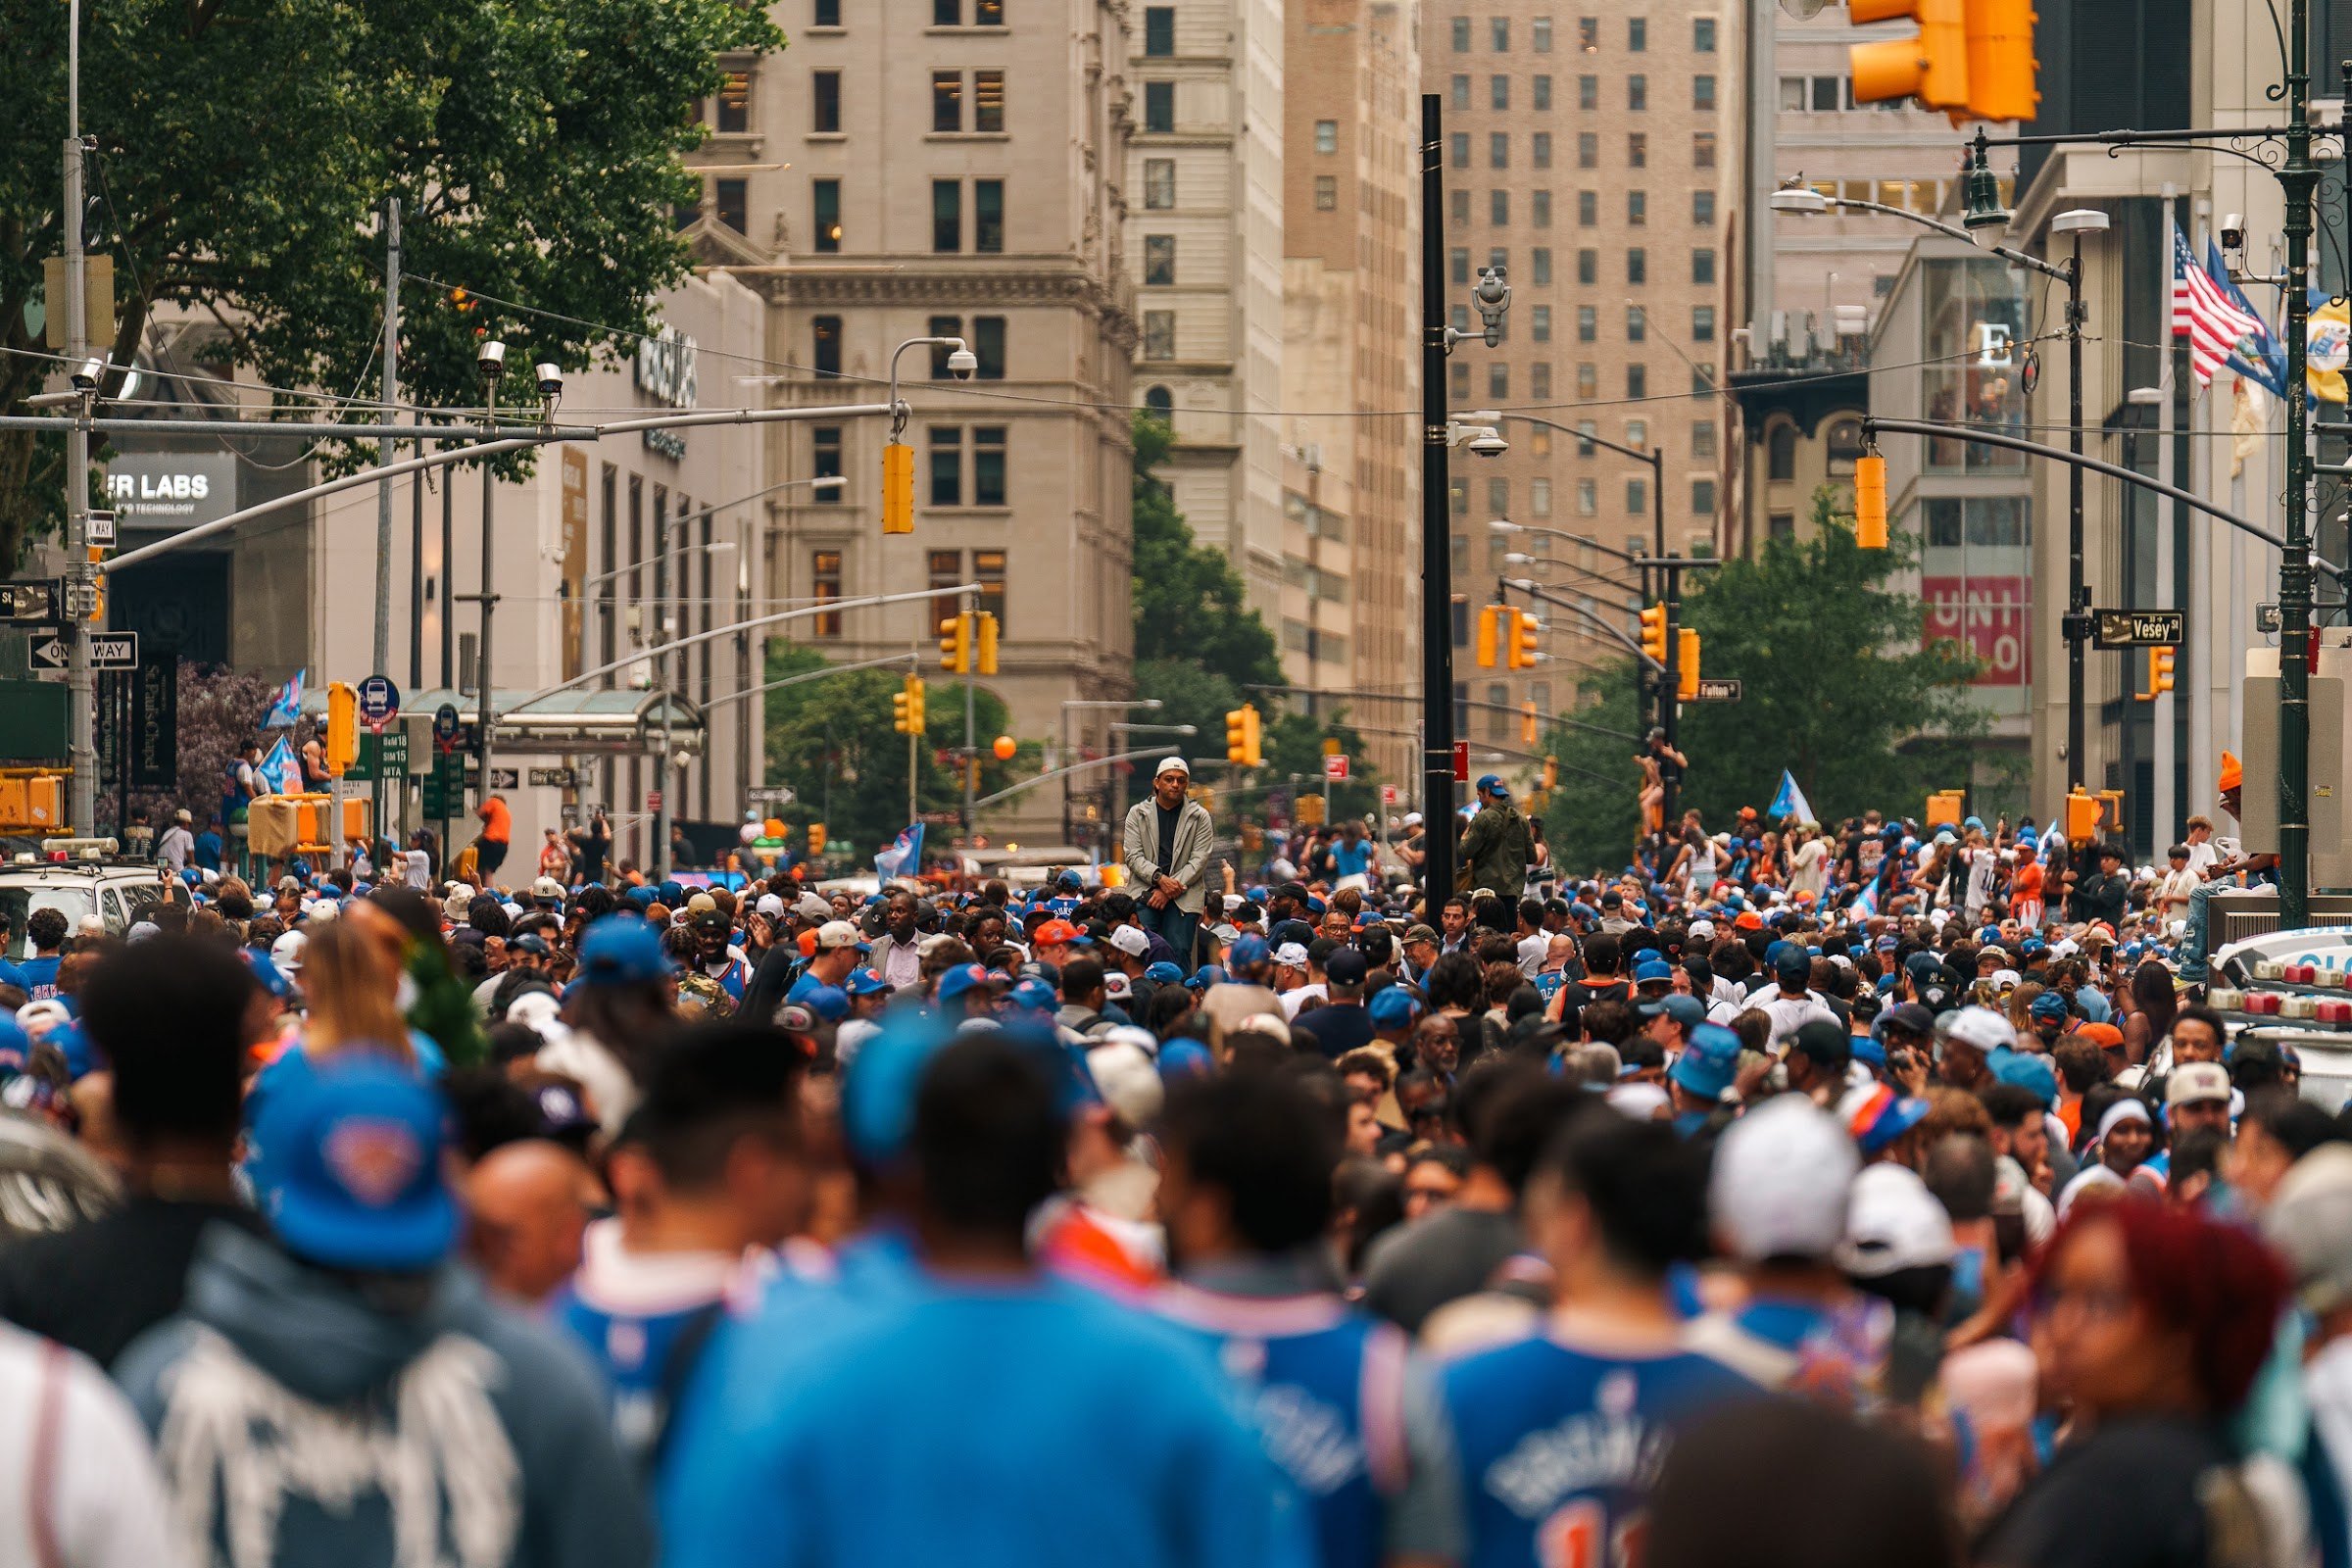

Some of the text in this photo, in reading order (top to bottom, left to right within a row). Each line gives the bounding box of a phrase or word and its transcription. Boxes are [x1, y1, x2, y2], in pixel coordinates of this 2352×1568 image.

[140, 474, 209, 500] LABS
[135, 502, 195, 515] TECHNOLOGY
[95, 521, 110, 536] WAY
[1, 592, 12, 604] St
[1935, 590, 2011, 627] UNI
[2133, 619, 2170, 643] Vesey
[2171, 619, 2179, 630] St
[50, 644, 124, 659] ON WAY
[1701, 683, 1729, 699] Fulton
[142, 720, 160, 769] Chapel
[382, 766, 402, 776] MTA
[1053, 906, 1074, 919] RUNS
